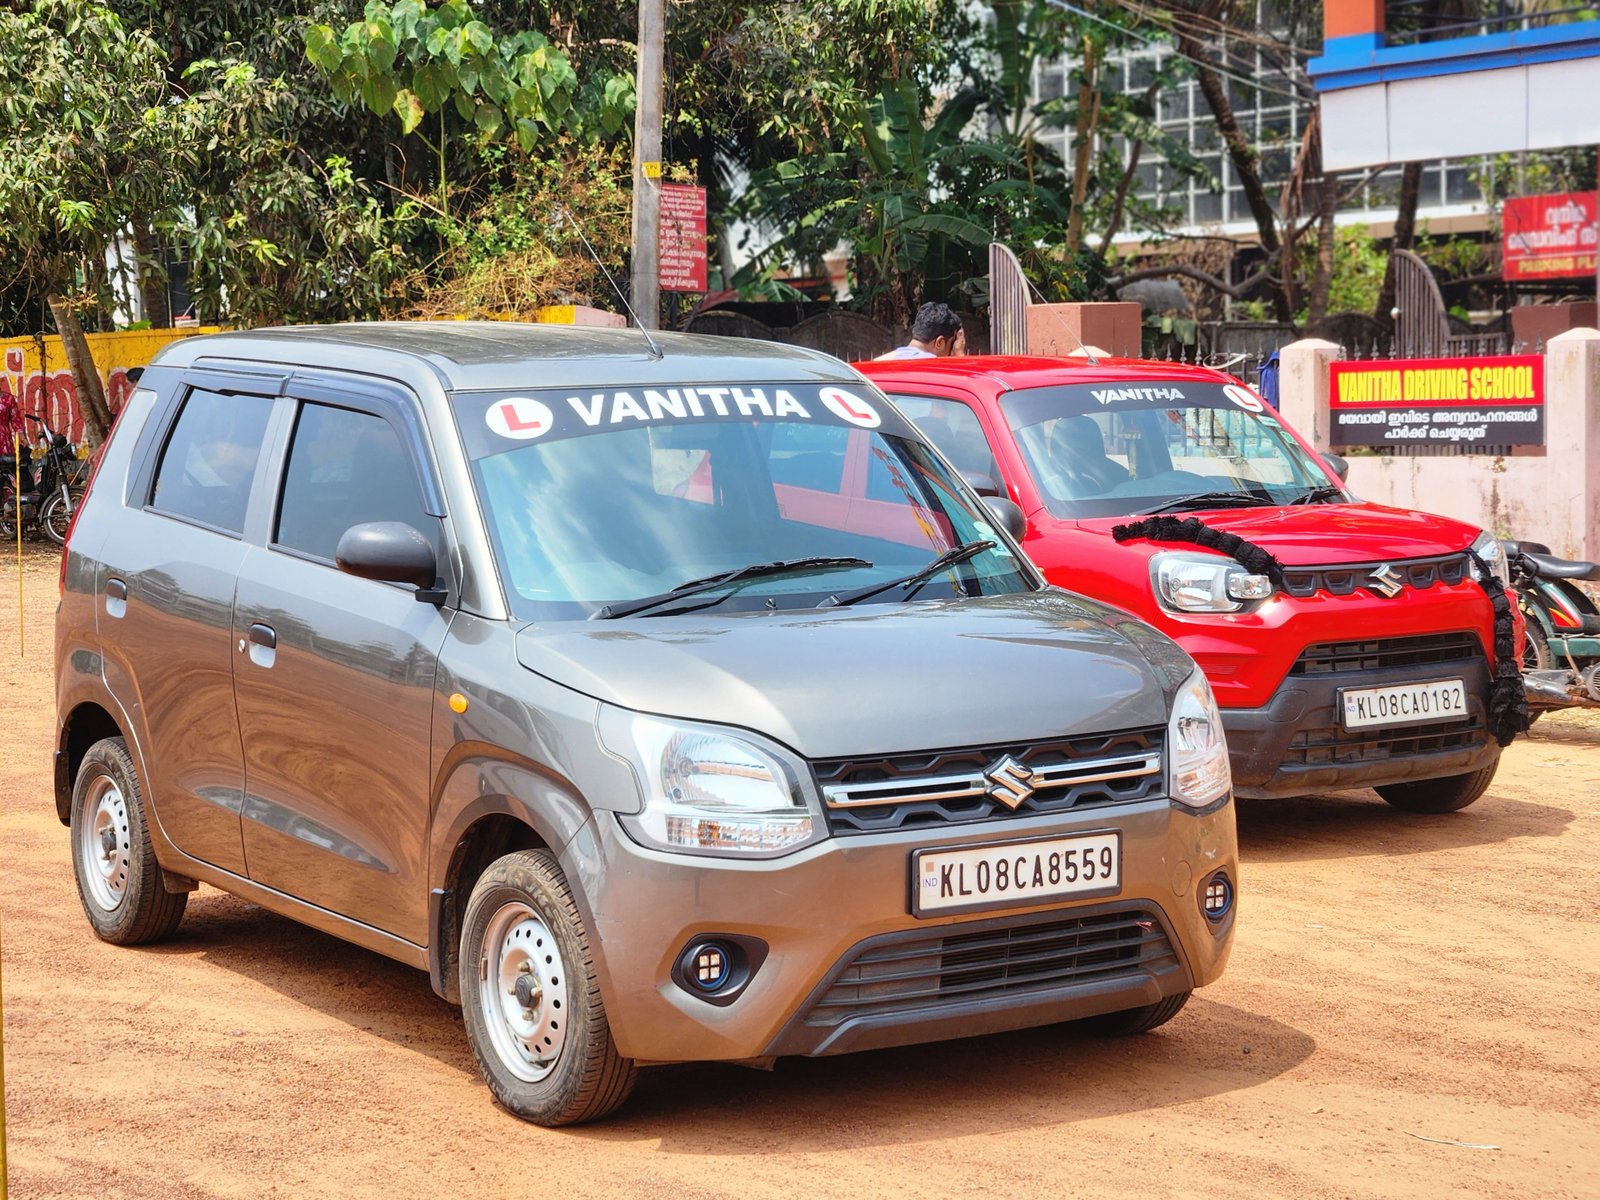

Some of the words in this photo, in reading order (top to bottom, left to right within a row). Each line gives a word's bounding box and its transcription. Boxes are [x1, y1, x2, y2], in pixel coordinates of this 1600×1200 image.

[1518, 257, 1574, 274] PARKING
[1338, 370, 1402, 403] VANITHA
[1403, 367, 1468, 401] DRIVING
[1470, 365, 1535, 400] SCHOOL
[1090, 388, 1186, 405] VANITHA
[1228, 388, 1259, 407] L
[499, 402, 542, 432] L
[566, 387, 812, 427] VANITHA
[831, 393, 874, 420] L
[1338, 410, 1387, 425] ദയവായി
[1388, 409, 1431, 427] ഇവിടെ
[1384, 424, 1430, 439] പാർക്ക്
[1430, 424, 1488, 441] ചെയ്യരുത്
[1357, 687, 1461, 719] KL08CA0182
[940, 846, 1113, 898] KL08CA8559
[922, 877, 938, 889] IND
